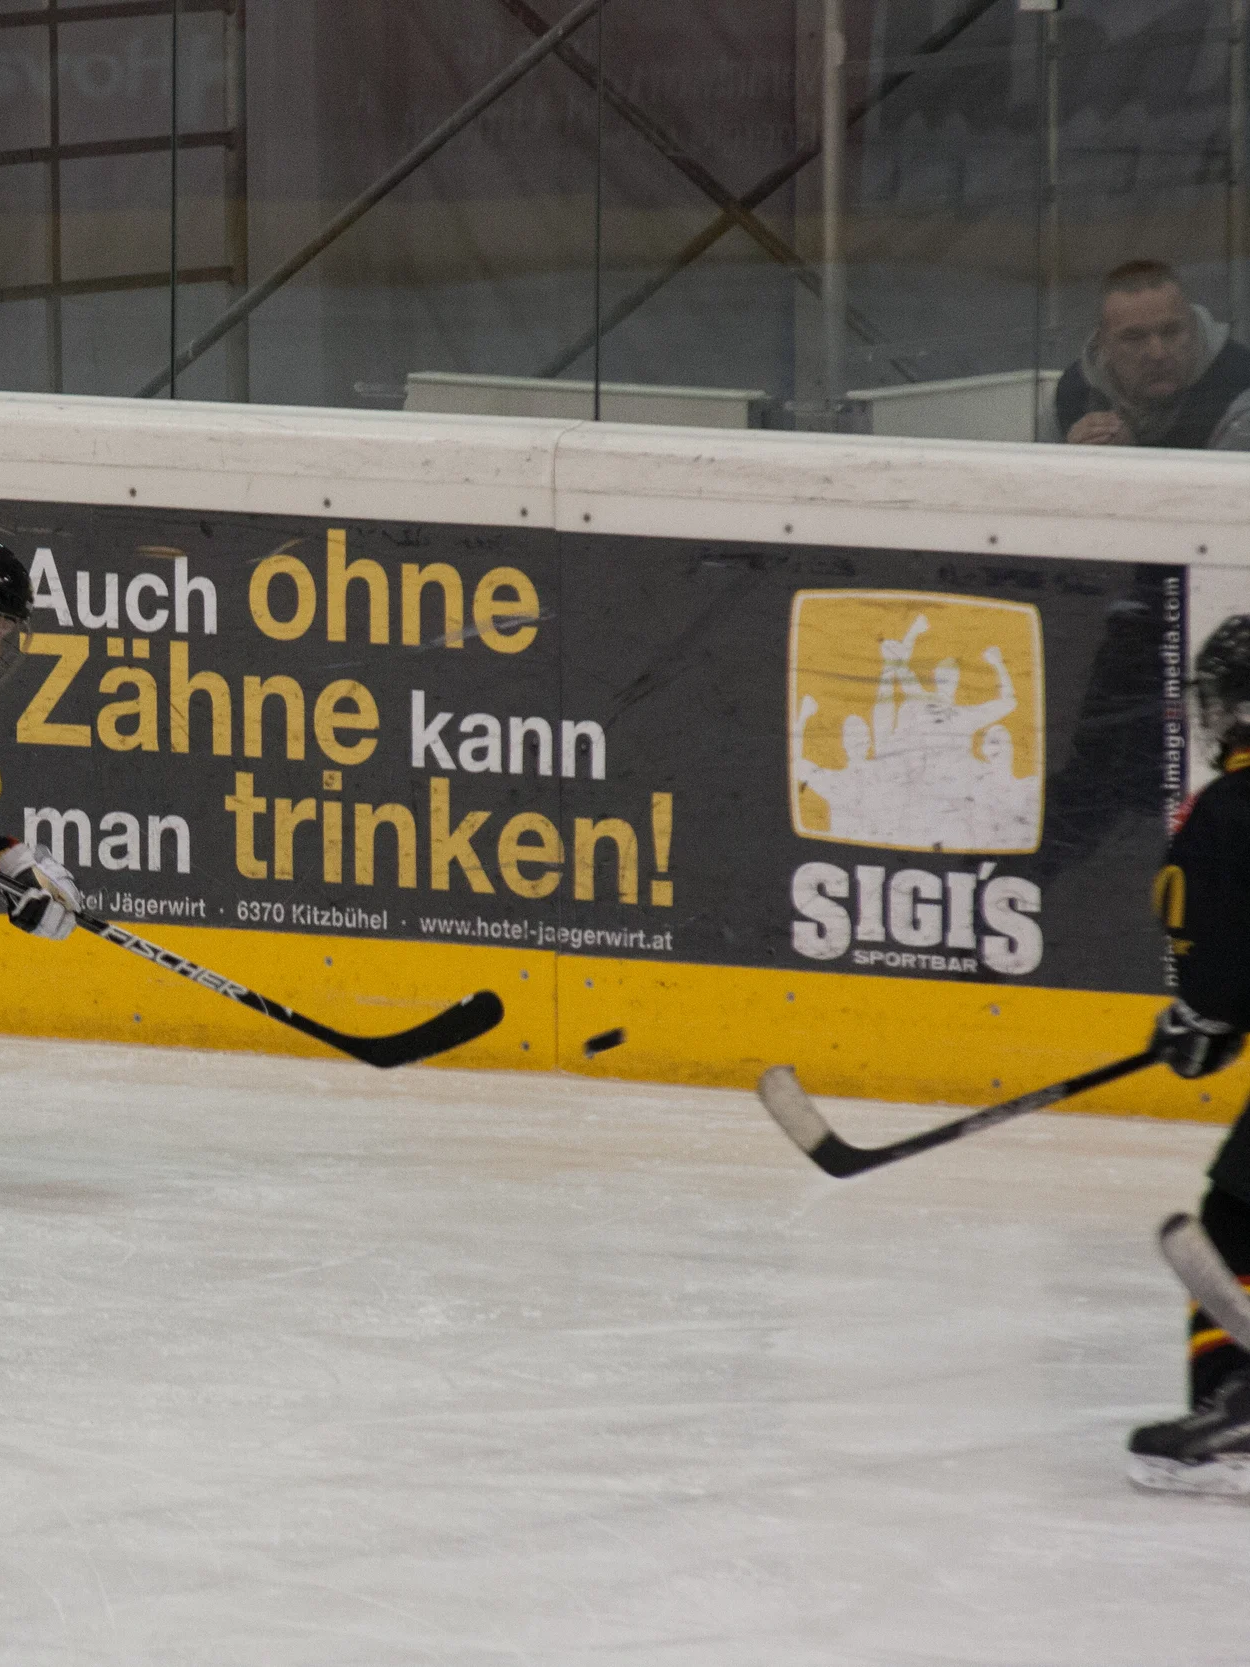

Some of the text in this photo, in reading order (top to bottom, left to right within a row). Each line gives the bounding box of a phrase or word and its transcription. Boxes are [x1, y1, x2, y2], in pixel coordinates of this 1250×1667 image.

[29, 528, 540, 655] Auch ohne
[16, 631, 607, 780] Zähne kann
[23, 769, 674, 908] man trinken!
[101, 924, 248, 1002] FISCHER
[110, 891, 206, 918] Jägerwirt
[237, 900, 285, 923] 6370
[292, 904, 389, 930] Kitzbühel
[419, 916, 674, 951] www.hotel-jaegerwirt.at
[792, 860, 1044, 976] SIGI'S
[853, 950, 979, 973] SPORTBAR
